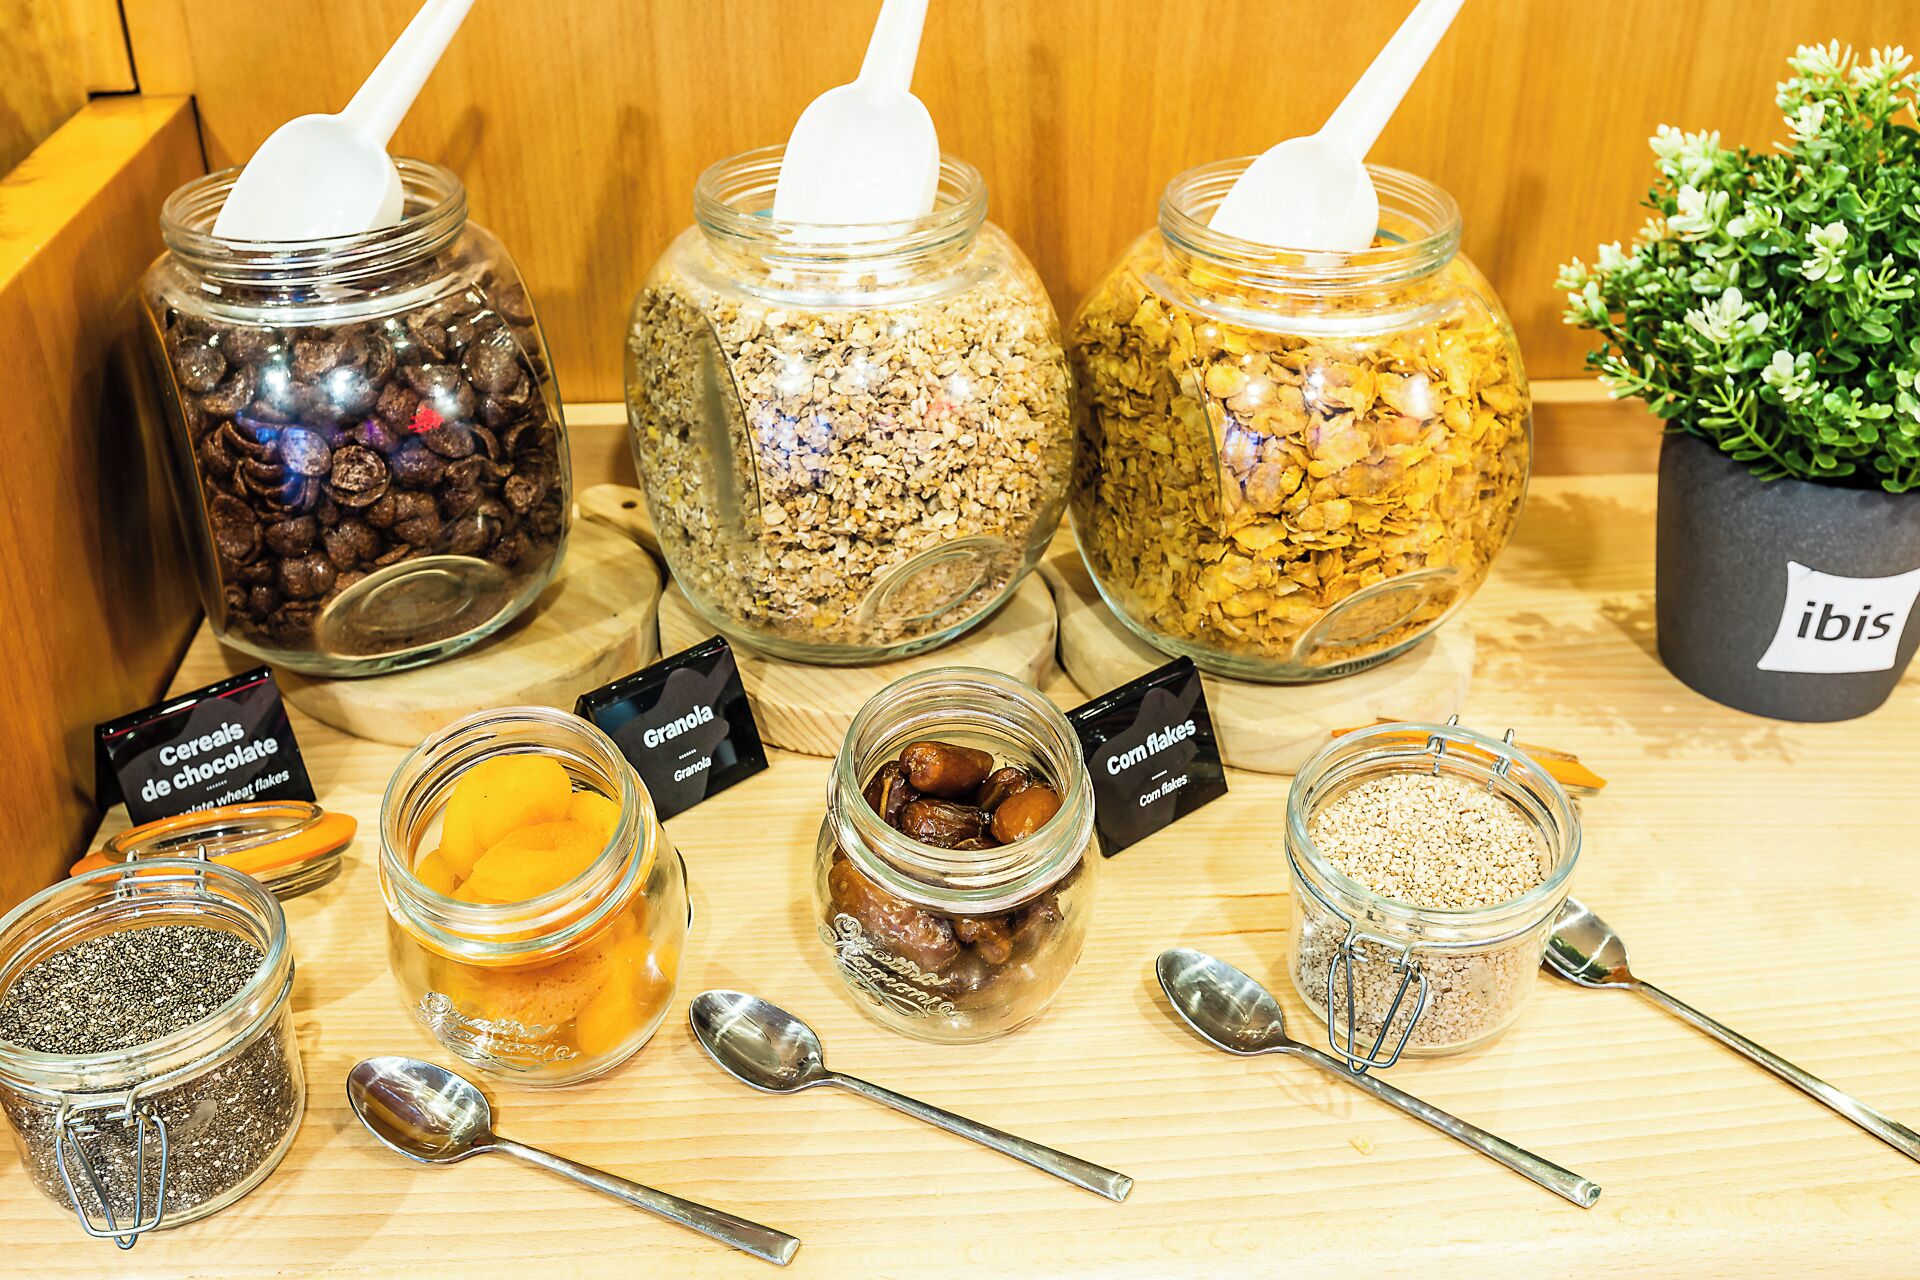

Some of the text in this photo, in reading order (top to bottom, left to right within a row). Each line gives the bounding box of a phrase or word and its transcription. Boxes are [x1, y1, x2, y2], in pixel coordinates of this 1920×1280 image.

[1797, 600, 1894, 641] ibis
[159, 722, 244, 766] Cereals
[643, 704, 714, 748] Granola
[1107, 719, 1196, 776] Corn flakes
[141, 738, 278, 802] de chocolate
[216, 785, 254, 806] wheat
[254, 769, 289, 791] flakes
[674, 756, 712, 782] Granola
[1139, 774, 1187, 807] Corn flakes
